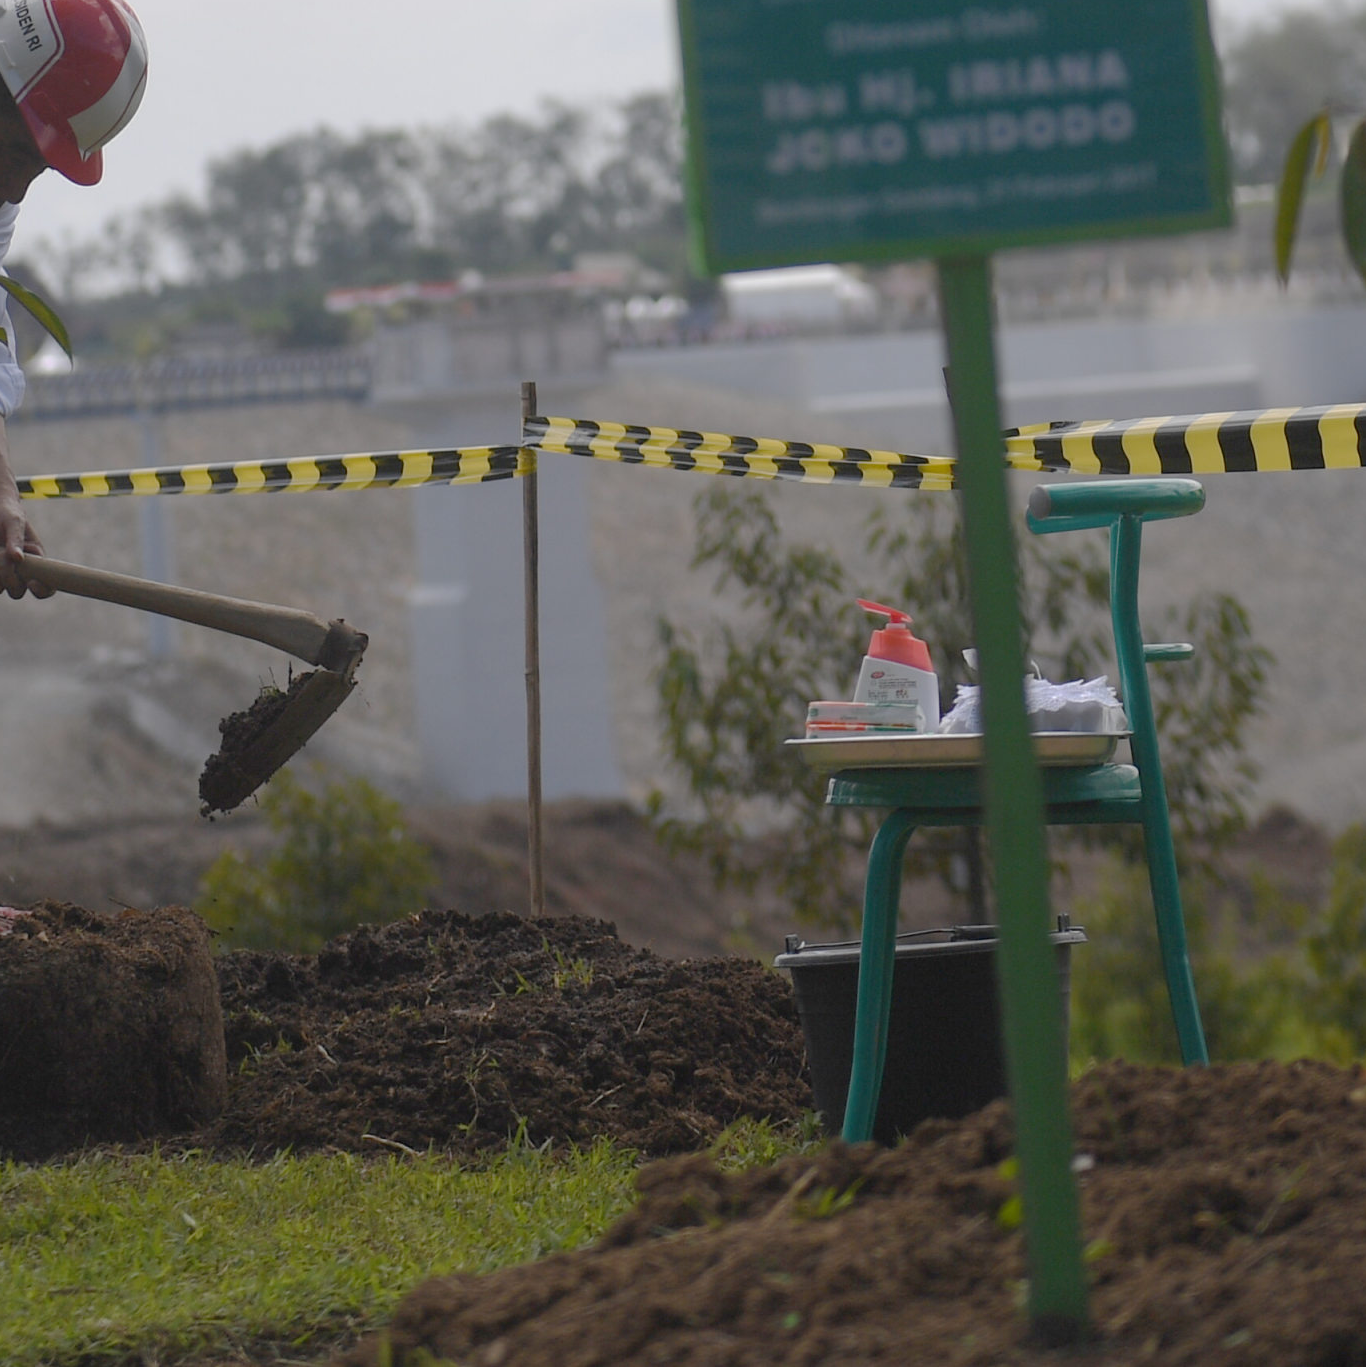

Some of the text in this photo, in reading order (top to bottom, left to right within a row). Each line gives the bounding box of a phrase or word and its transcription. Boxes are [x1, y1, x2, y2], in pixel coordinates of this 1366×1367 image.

[26, 34, 43, 52] RI
[950, 50, 1126, 102] IRIANA
[767, 101, 1134, 173] JOKO WIDODO
